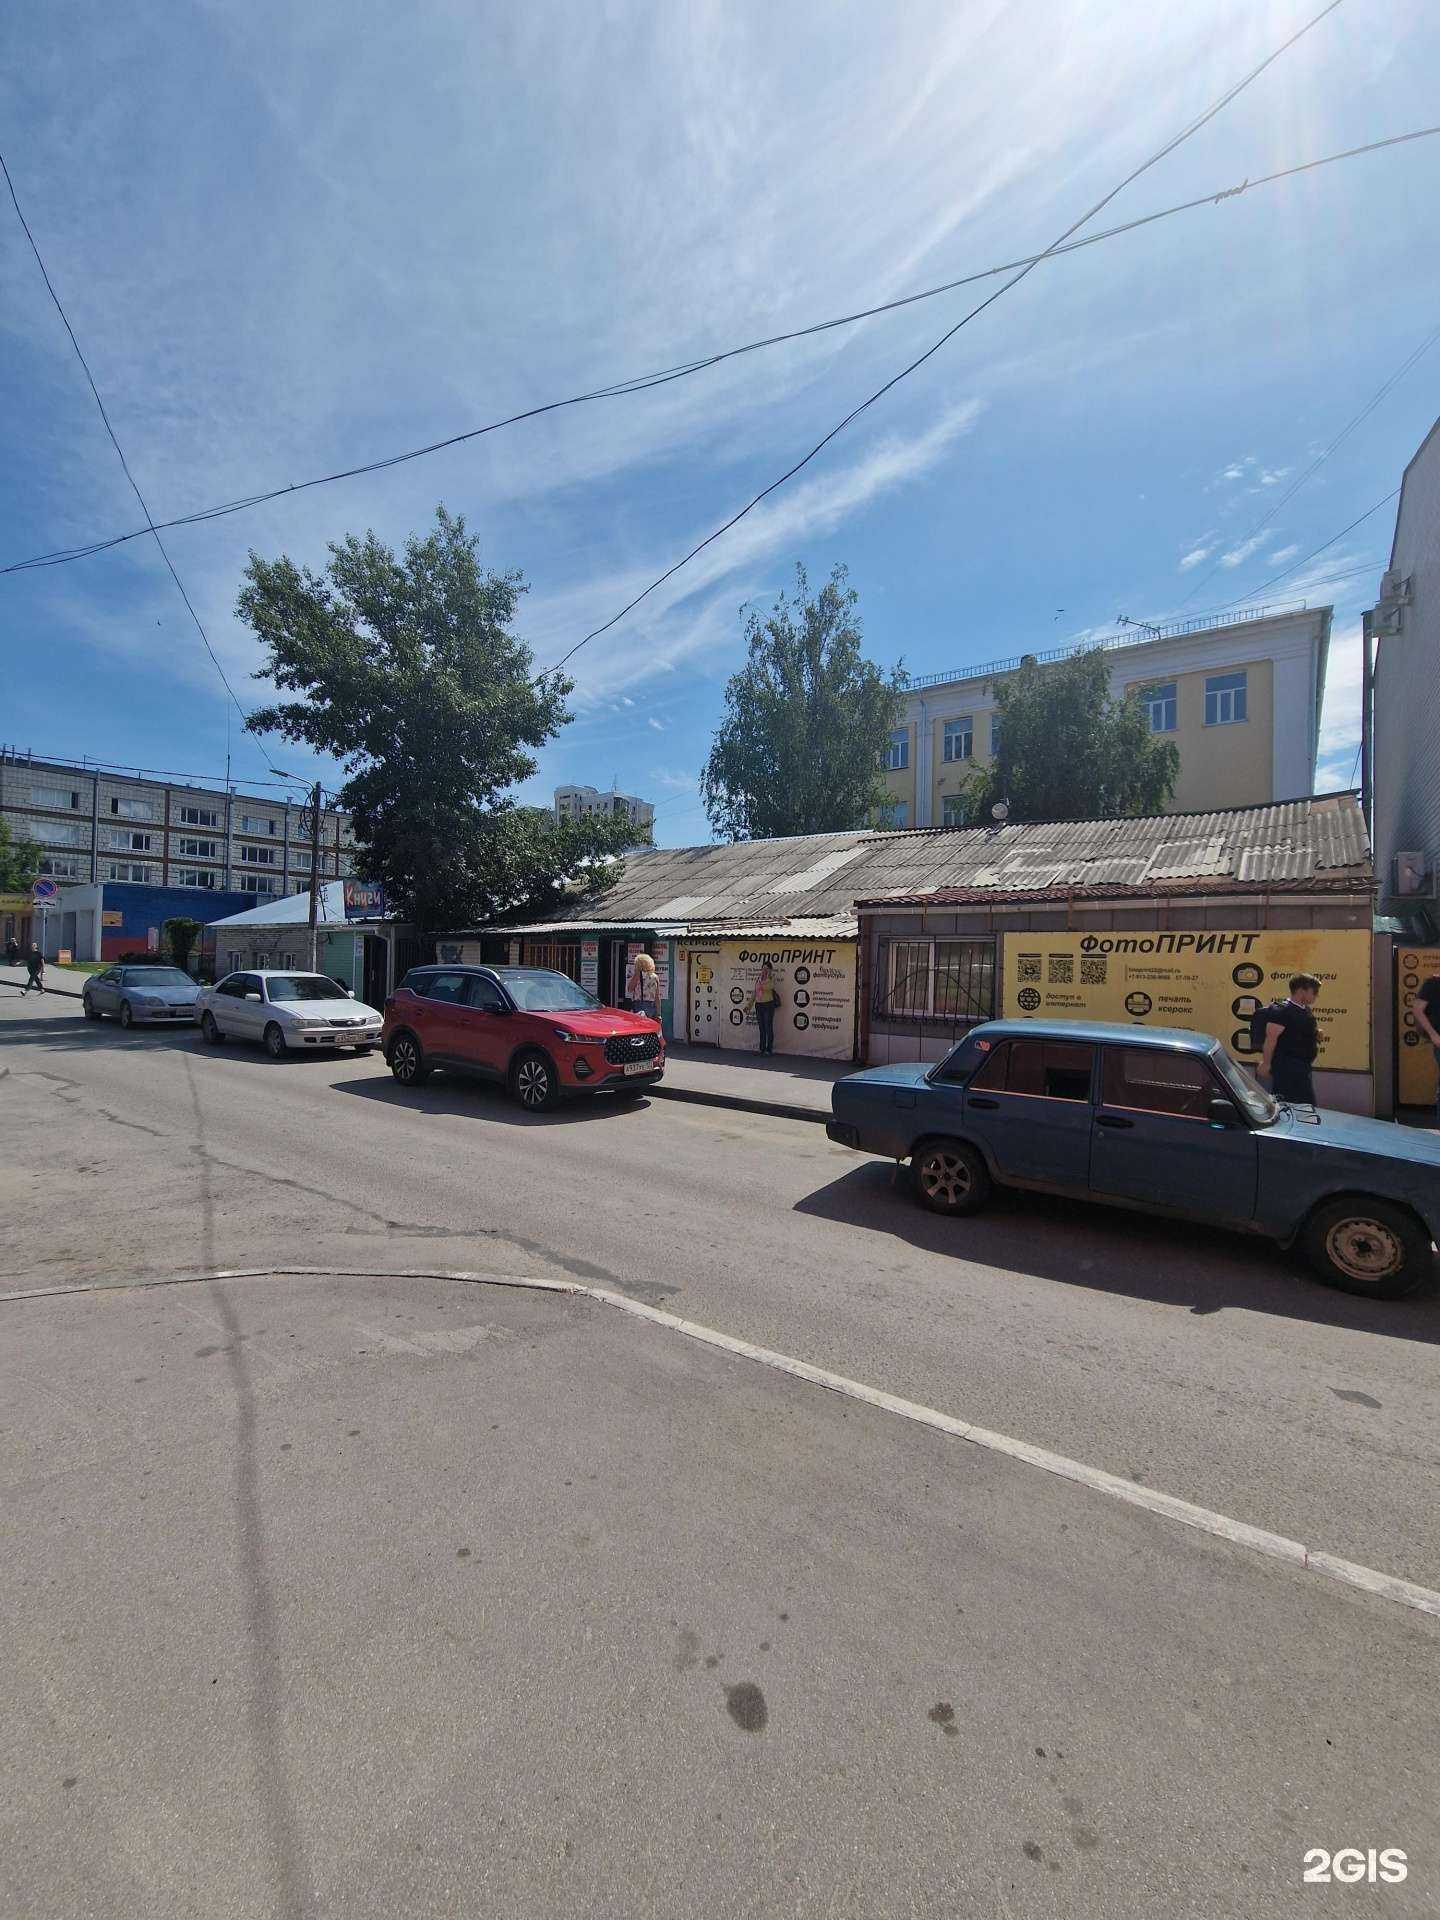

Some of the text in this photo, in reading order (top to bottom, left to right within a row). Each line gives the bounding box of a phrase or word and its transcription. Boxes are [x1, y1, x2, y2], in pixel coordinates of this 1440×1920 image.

[346, 885, 381, 906] Книги
[1080, 934, 1260, 954] ФотоПРИНТ
[739, 949, 836, 964] ФотоПРИНТ
[1158, 1006, 1193, 1014] ксерокс
